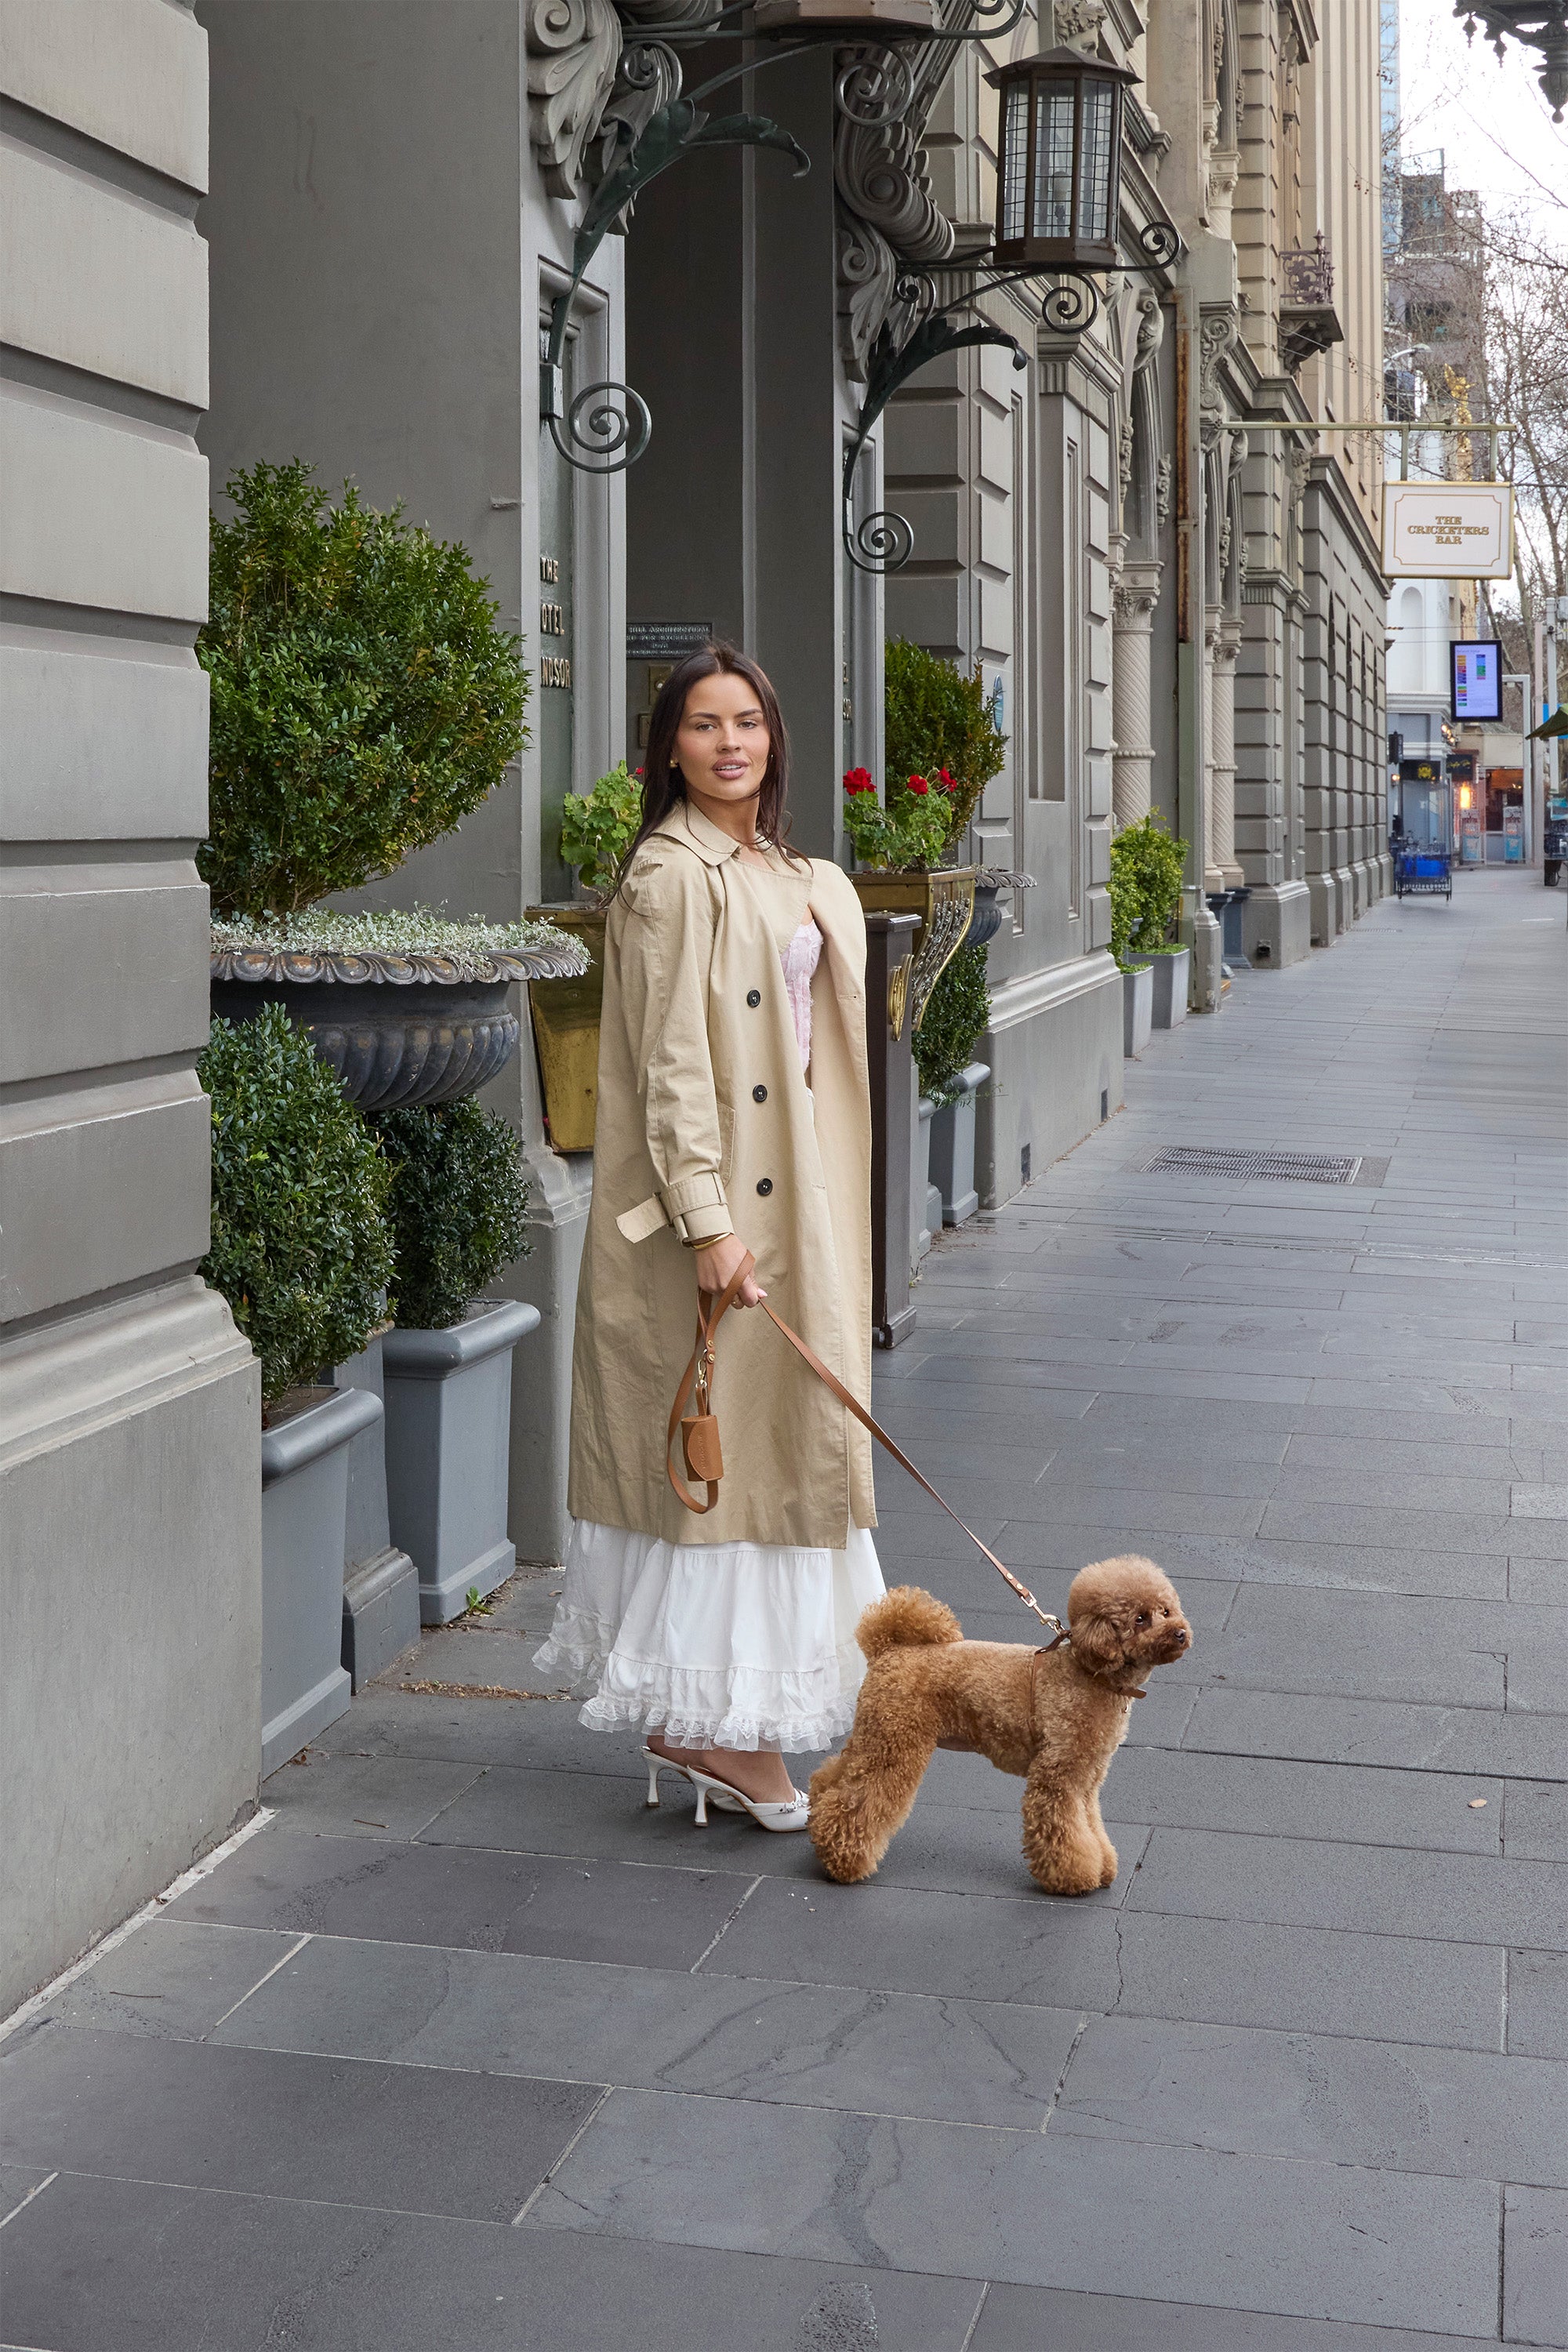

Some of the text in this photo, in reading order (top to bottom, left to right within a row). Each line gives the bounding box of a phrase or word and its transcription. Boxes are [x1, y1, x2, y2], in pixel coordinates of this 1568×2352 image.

[1435, 516, 1462, 524] THE
[1407, 525, 1490, 535] CRICKETERS
[1435, 535, 1462, 544] BAR
[541, 557, 559, 583] THE
[541, 603, 564, 636] OTEL
[541, 656, 571, 688] NDSOR
